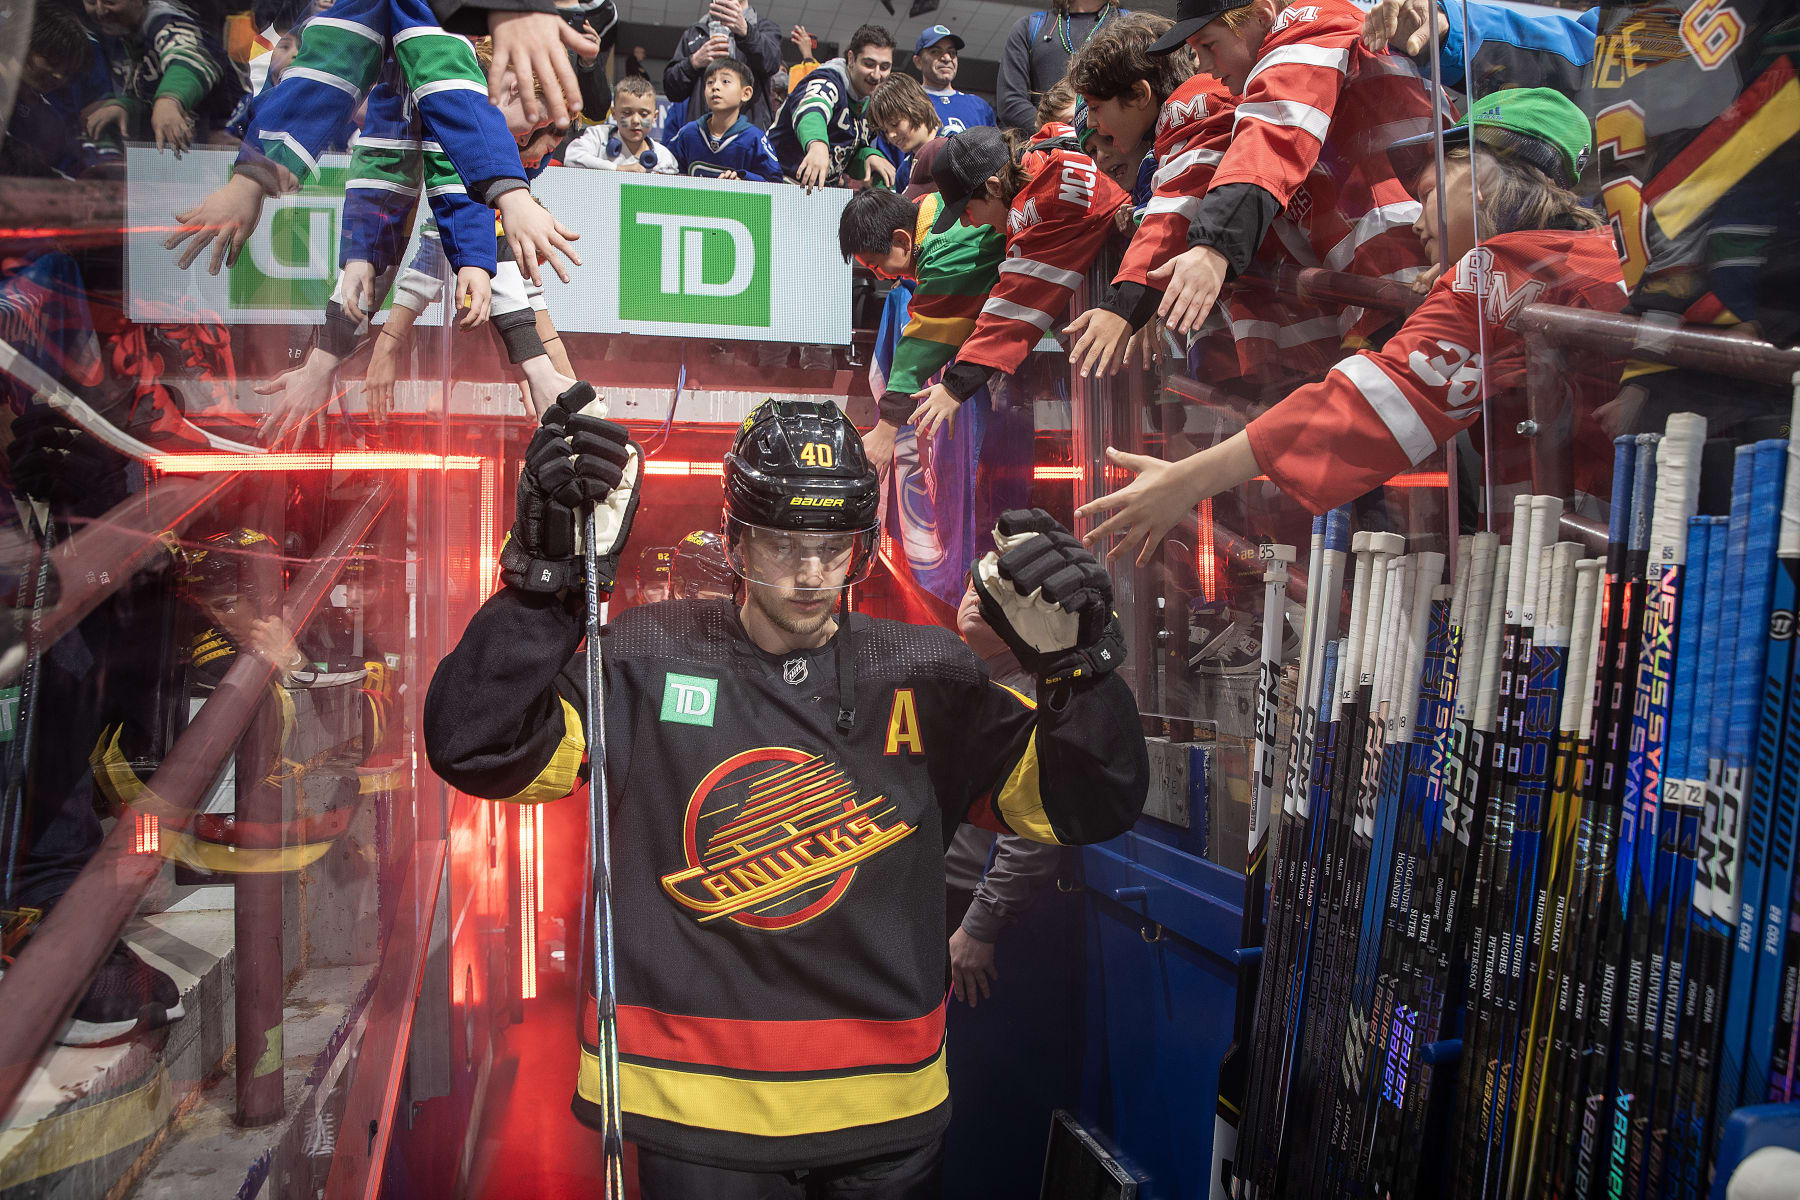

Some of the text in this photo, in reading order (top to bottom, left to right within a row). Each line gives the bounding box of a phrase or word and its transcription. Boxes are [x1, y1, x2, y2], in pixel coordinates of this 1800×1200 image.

[636, 212, 755, 297] TD
[800, 442, 833, 468] 40
[1260, 545, 1274, 559] 35
[670, 683, 711, 716] TD
[884, 688, 925, 756] A
[1618, 580, 1661, 844] NEXUS SYNC
[1639, 565, 1677, 836] NEXUS SYNC
[1285, 705, 1303, 799] CCM
[1298, 705, 1316, 801] CCM
[1356, 717, 1378, 819] CCM
[1366, 717, 1386, 820] CCM
[1440, 718, 1467, 834] CCM
[1457, 730, 1484, 847] CCM
[1666, 781, 1679, 800] 72
[1686, 786, 1701, 805] 72
[1298, 861, 1308, 900] GARLAND
[1306, 867, 1317, 907] GARLAND
[1324, 853, 1332, 876] MILLER
[1336, 857, 1344, 881] MILLER
[1407, 908, 1418, 938] SUTER
[1433, 877, 1445, 920] DIGIUSEPPE
[1444, 889, 1457, 933] DIGIUSEPPE
[1533, 889, 1547, 945] FRIEDMAN
[1551, 895, 1565, 953] FRIEDMAN
[1419, 913, 1430, 943] SUTER
[1498, 931, 1511, 976] HUGHES
[1512, 934, 1524, 978] HUGHES
[1738, 922, 1752, 953] COLE
[1765, 924, 1780, 957] COLE
[1469, 927, 1483, 990] PETTERSSON
[1482, 935, 1498, 1000] PETTERSSON
[1368, 983, 1384, 1046] BAUER
[1379, 988, 1395, 1050] BAUER
[1559, 974, 1571, 1012] MYERS
[1574, 982, 1586, 1020] MYERS
[1599, 963, 1616, 1028] MIKHEYEV
[1625, 959, 1643, 1025] MIKHEYEV
[1644, 952, 1664, 1032] BEAUVILLIER
[1662, 959, 1682, 1040] BEAUVILLIER
[1685, 978, 1698, 1017] JOSHUA
[1703, 984, 1716, 1024] JOSHUA
[1383, 1018, 1402, 1101] BAUER
[1394, 1024, 1414, 1110] BAUER
